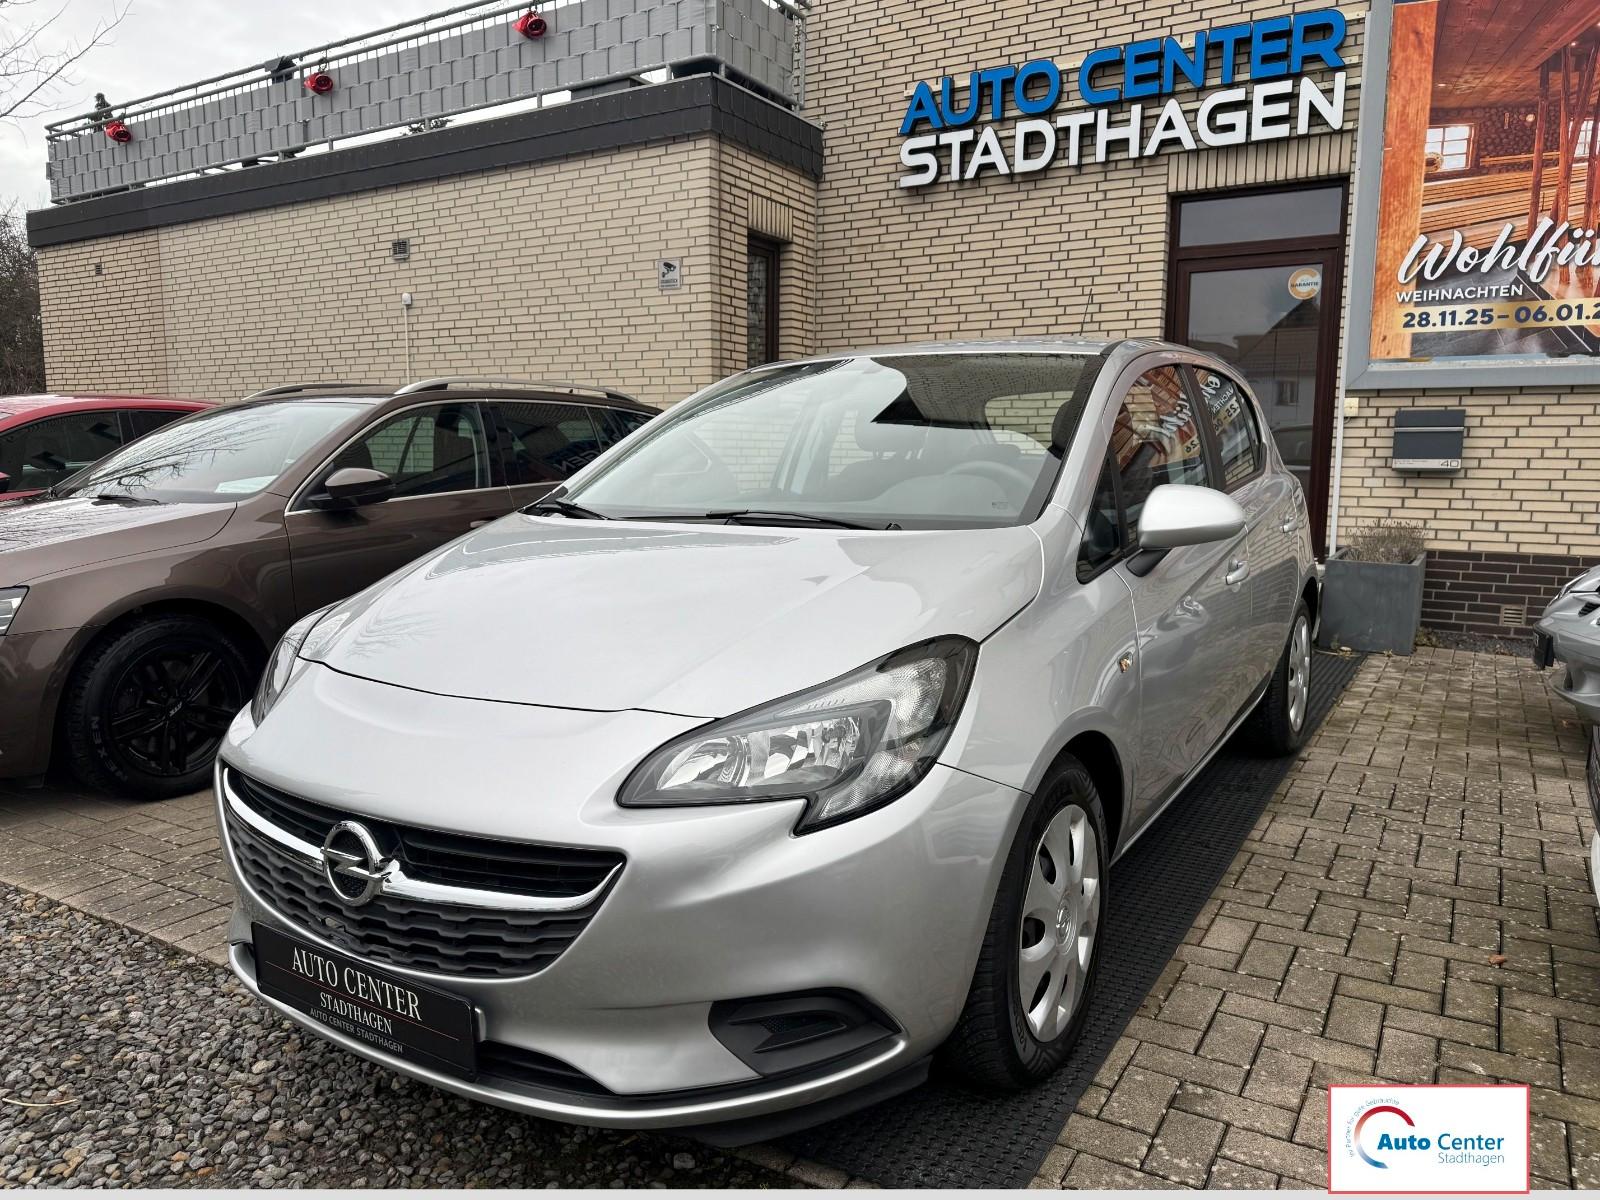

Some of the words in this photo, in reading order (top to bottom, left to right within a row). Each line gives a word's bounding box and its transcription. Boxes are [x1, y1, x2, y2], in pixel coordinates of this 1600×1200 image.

[900, 59, 1062, 135] AUTO
[1078, 8, 1348, 106] CENTER
[899, 71, 1347, 189] STADTHAGEN
[1397, 217, 1600, 284] Wohlfü
[1396, 284, 1523, 303] WEIHNACHTEN
[1441, 459, 1459, 468] 40
[292, 947, 339, 987] AUTO
[344, 967, 422, 1021] CENTER
[310, 1008, 328, 1022] AUTO
[329, 1016, 355, 1033] CENTER
[356, 1027, 403, 1054] STADTHAGEN
[320, 992, 392, 1035] STADTHAGEN
